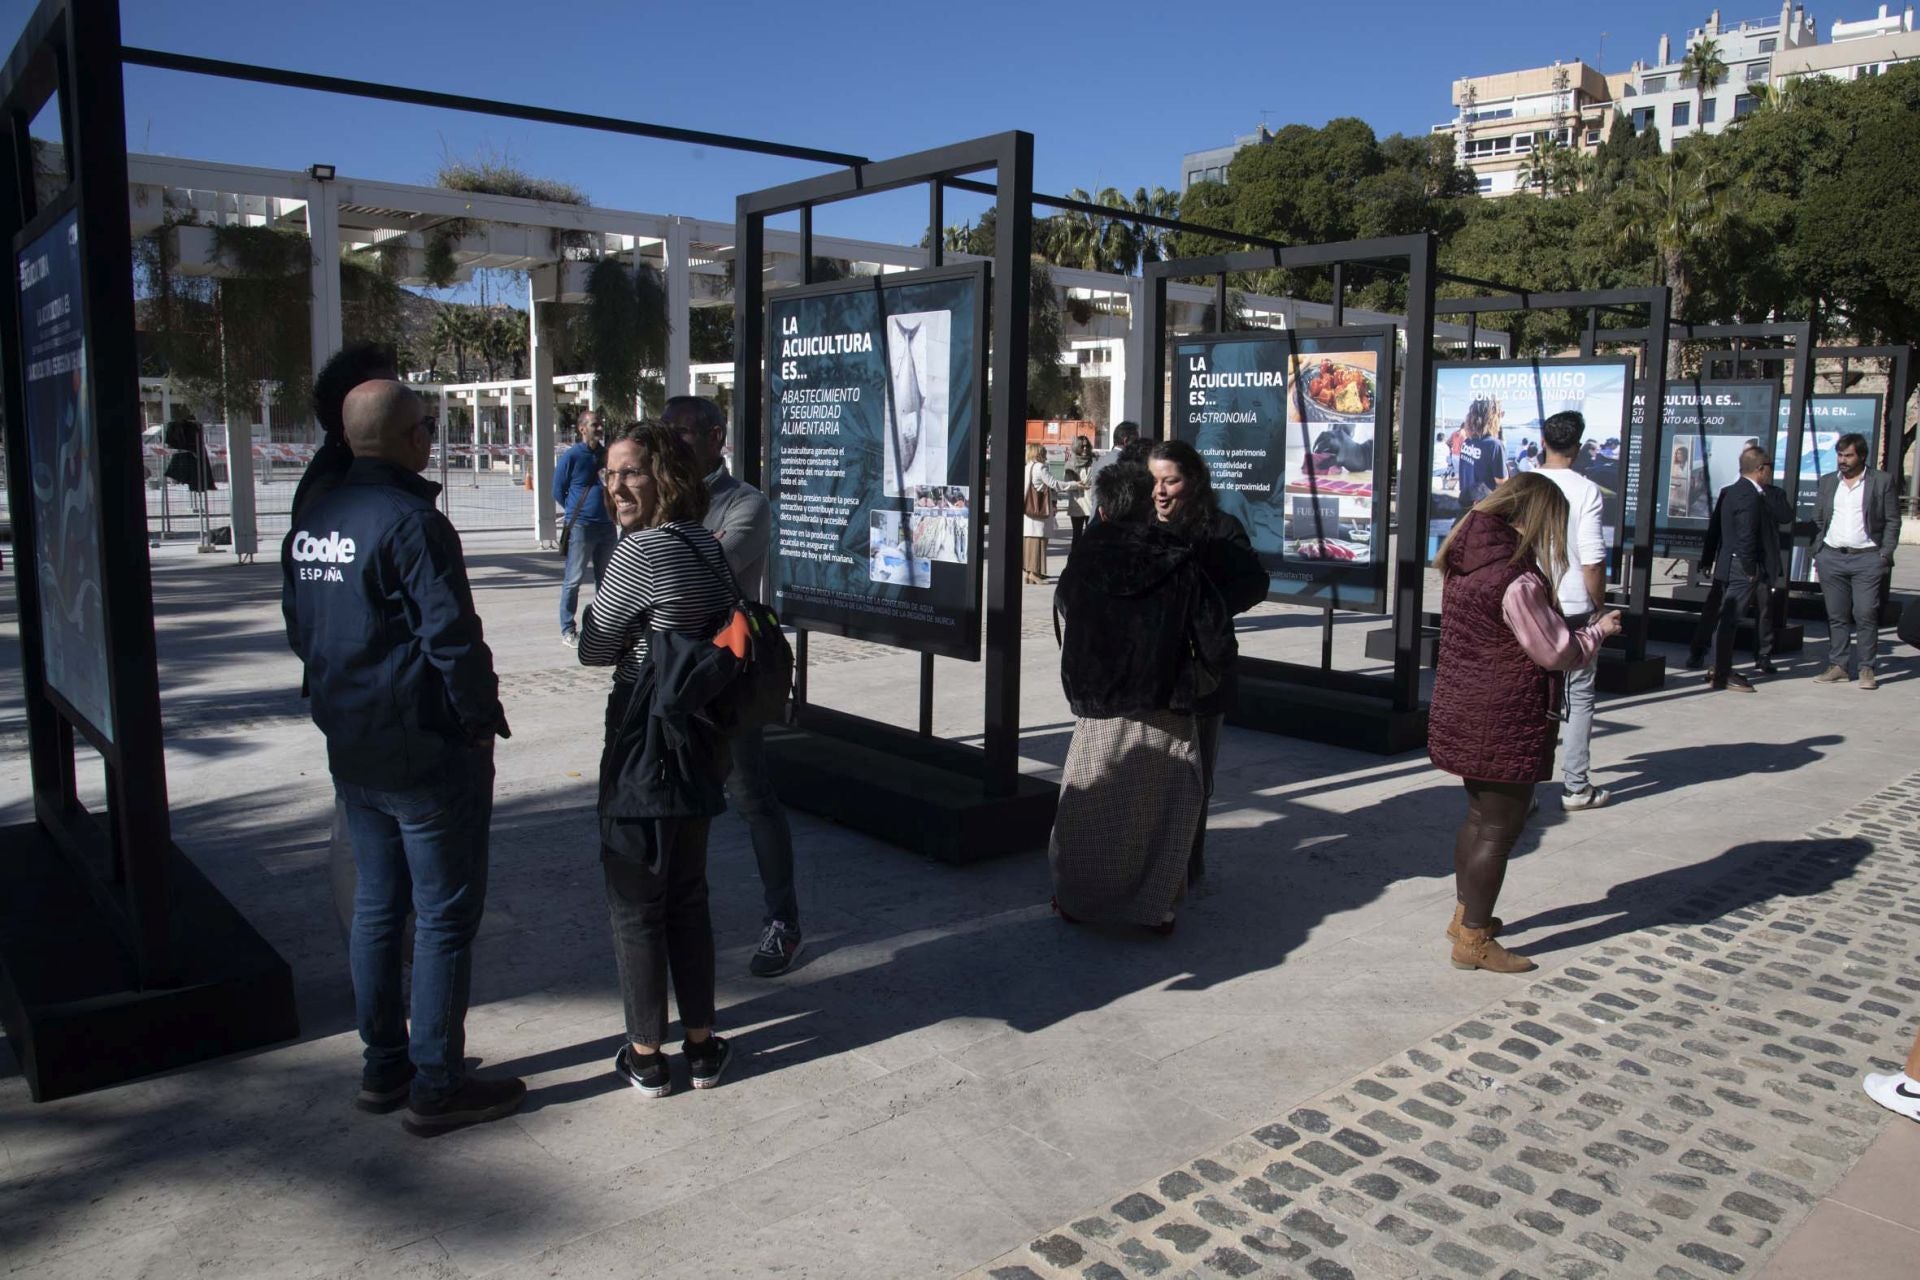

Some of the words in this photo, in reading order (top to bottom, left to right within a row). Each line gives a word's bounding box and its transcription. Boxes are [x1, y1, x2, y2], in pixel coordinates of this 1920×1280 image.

[782, 316, 798, 335] LA
[782, 332, 872, 358] ACUICULTURA
[782, 361, 807, 380] ES...
[1190, 356, 1206, 371] LA
[1189, 372, 1283, 388] ACUICULTURA
[1470, 372, 1586, 389] COMPROMISO
[782, 388, 860, 404] ABASTECIMIENTO
[1190, 391, 1216, 406] ES...
[1470, 390, 1492, 400] CON
[1496, 390, 1508, 400] LA
[1715, 394, 1740, 406] ES...
[782, 406, 788, 419] Y
[790, 404, 841, 419] SEGURIDAD
[1189, 410, 1257, 424] GASTRONOMÍA
[782, 421, 840, 436] ALIMENTARIA
[788, 446, 814, 455] acuicultura
[815, 448, 838, 457] garantiza
[1204, 448, 1225, 456] cultura
[1231, 450, 1266, 458] patrimonio
[781, 457, 806, 465] suministro
[806, 458, 831, 466] constante
[1213, 461, 1247, 469] creatividad
[781, 467, 804, 475] productos
[825, 469, 845, 477] durante
[1235, 482, 1270, 491] proximidad
[781, 492, 797, 500] Reduce
[822, 494, 837, 504] sobre
[844, 498, 859, 506] pesca
[1297, 508, 1336, 516] FUETES
[292, 530, 356, 563] Cooke
[300, 566, 344, 582] ESPAÑA
